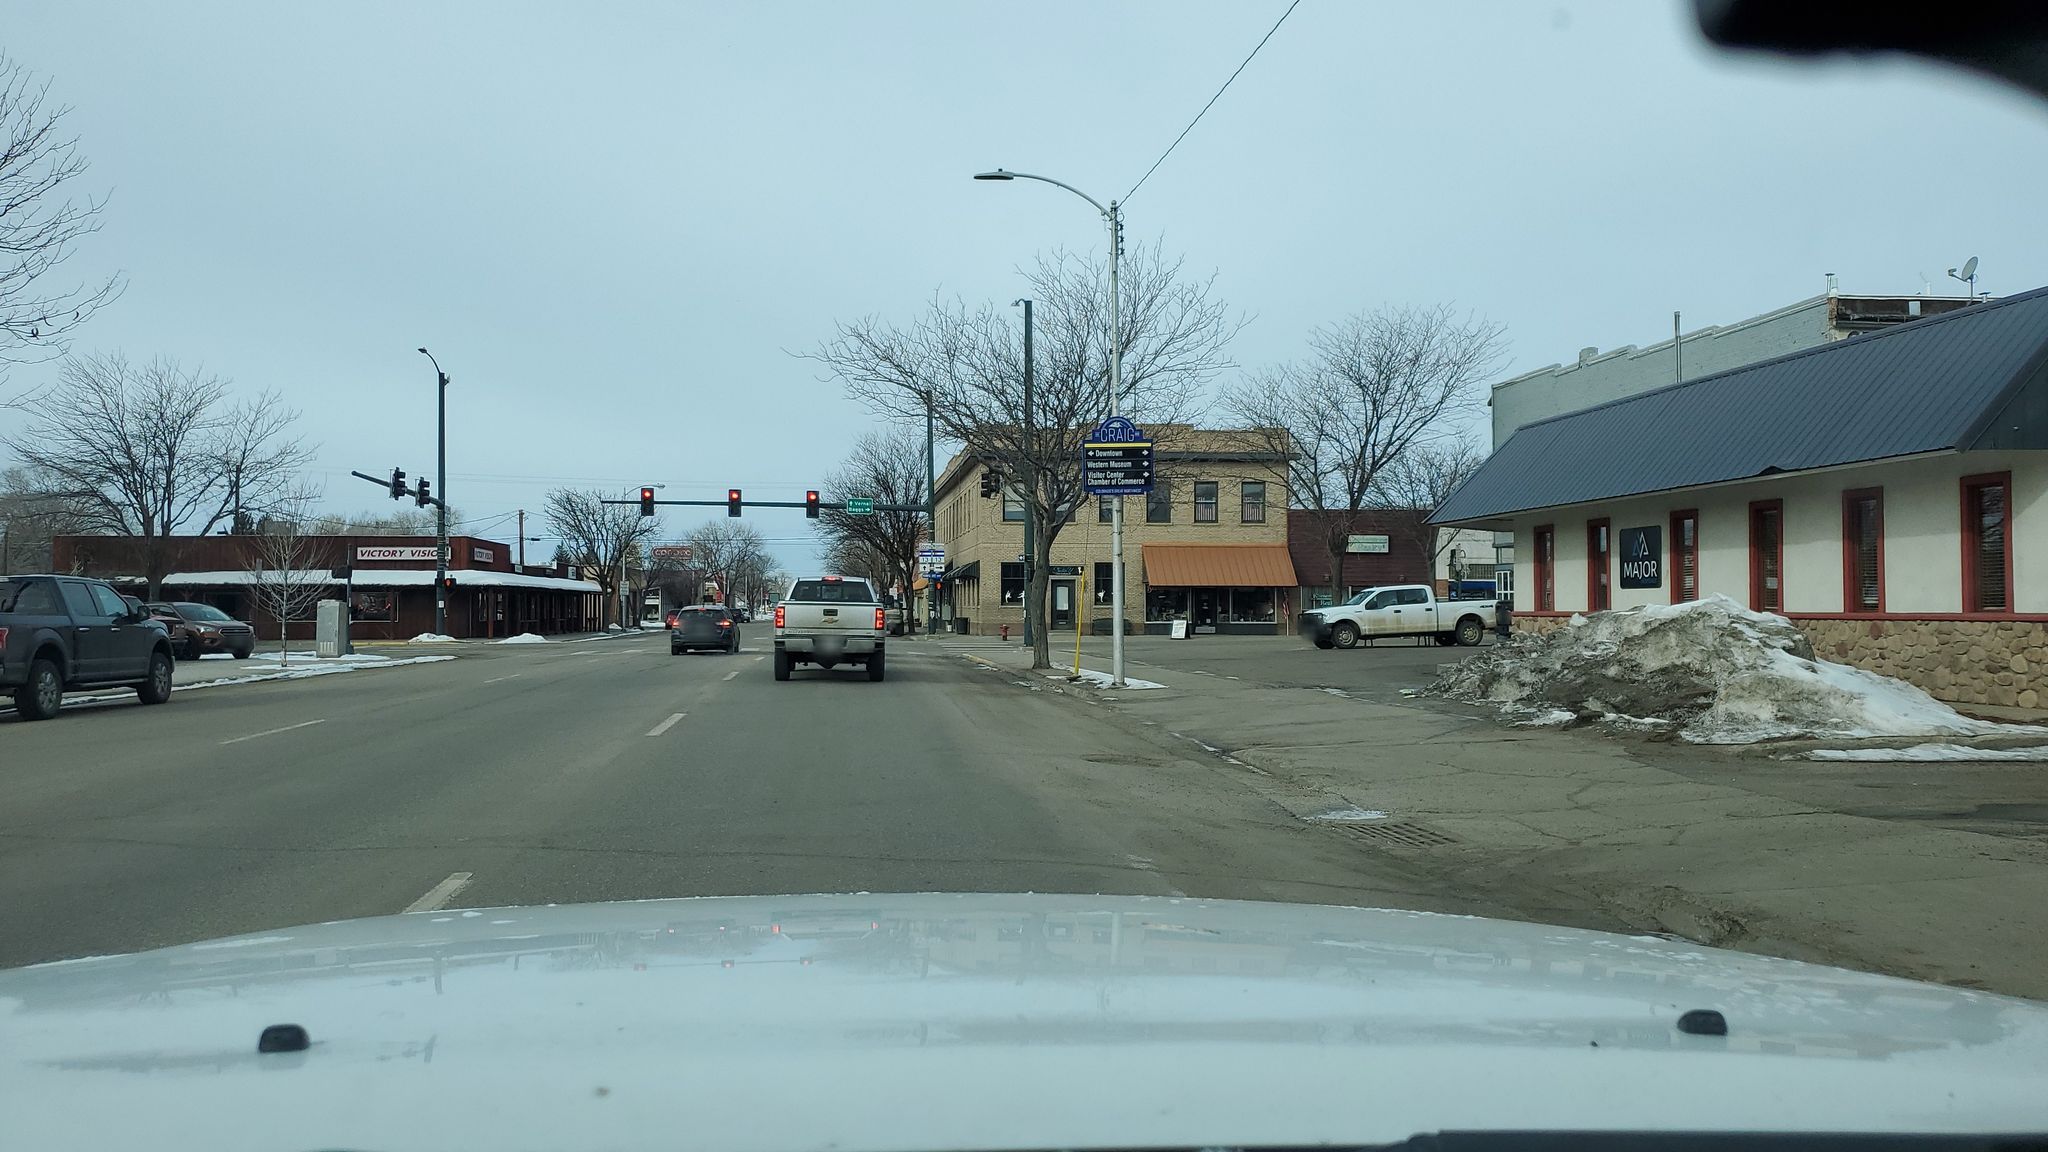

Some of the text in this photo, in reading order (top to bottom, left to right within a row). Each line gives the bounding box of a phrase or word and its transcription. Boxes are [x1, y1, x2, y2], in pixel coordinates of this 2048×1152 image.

[1100, 428, 1135, 442] CRAIG
[1087, 471, 1125, 479] Visitor Center
[1087, 478, 1110, 486] Chamber
[359, 549, 438, 558] VICTORY VISIO
[1623, 560, 1658, 580] MAJOR
